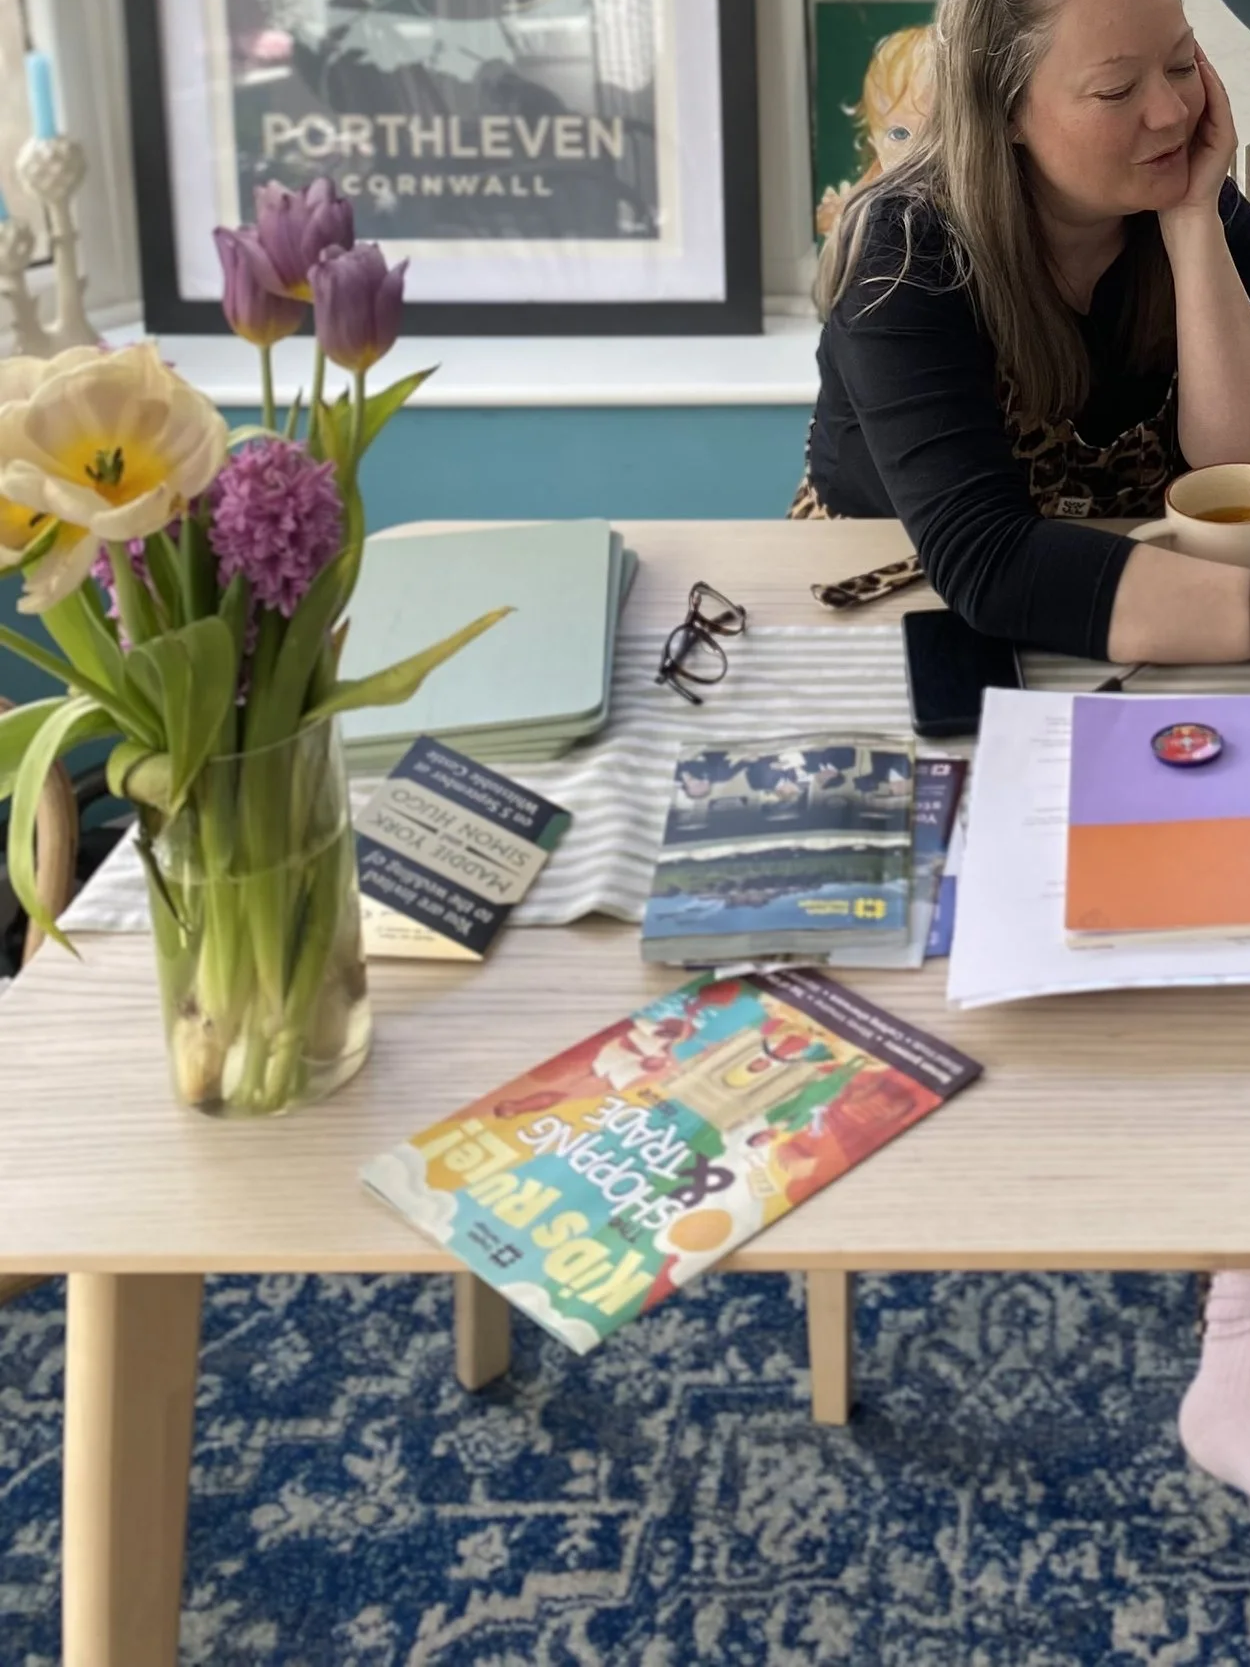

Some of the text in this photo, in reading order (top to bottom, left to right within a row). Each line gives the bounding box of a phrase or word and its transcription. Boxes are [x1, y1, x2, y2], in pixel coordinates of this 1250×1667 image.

[261, 112, 625, 160] PORTHLEVEN
[341, 173, 554, 197] CORNWALL
[425, 750, 540, 816] Whitstable Castle
[430, 770, 502, 813] September
[389, 788, 533, 868] SIMON HUGO
[511, 811, 534, 828] on
[366, 810, 512, 895] MADDIE YORK
[361, 869, 418, 905] invited
[361, 850, 496, 924] to the wedding of
[416, 896, 445, 920] are
[443, 910, 474, 937] You
[582, 1094, 693, 1182] TRADE
[515, 1115, 687, 1230] SHOPPING
